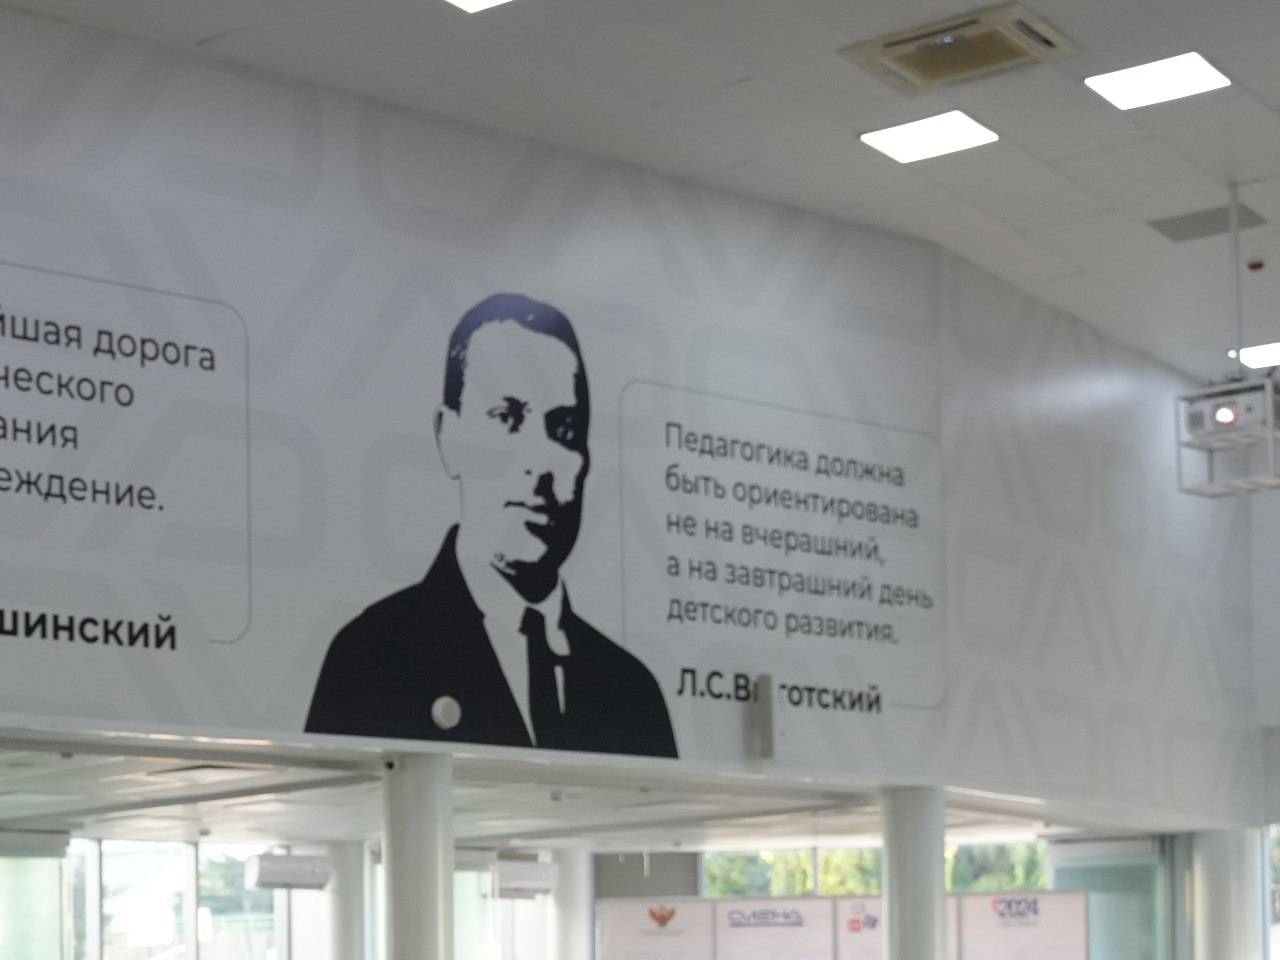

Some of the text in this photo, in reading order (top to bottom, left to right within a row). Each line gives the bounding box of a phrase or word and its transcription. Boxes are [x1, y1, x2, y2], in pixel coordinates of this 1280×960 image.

[93, 330, 215, 371] дорога
[666, 422, 905, 487] Педагогика должна
[665, 463, 919, 528] быть ориентирована
[667, 514, 884, 565] не на вчерашний,
[667, 556, 934, 610] а на завтрашний день
[667, 598, 898, 644] детского развития.
[677, 668, 881, 713] Л.С.Вотский
